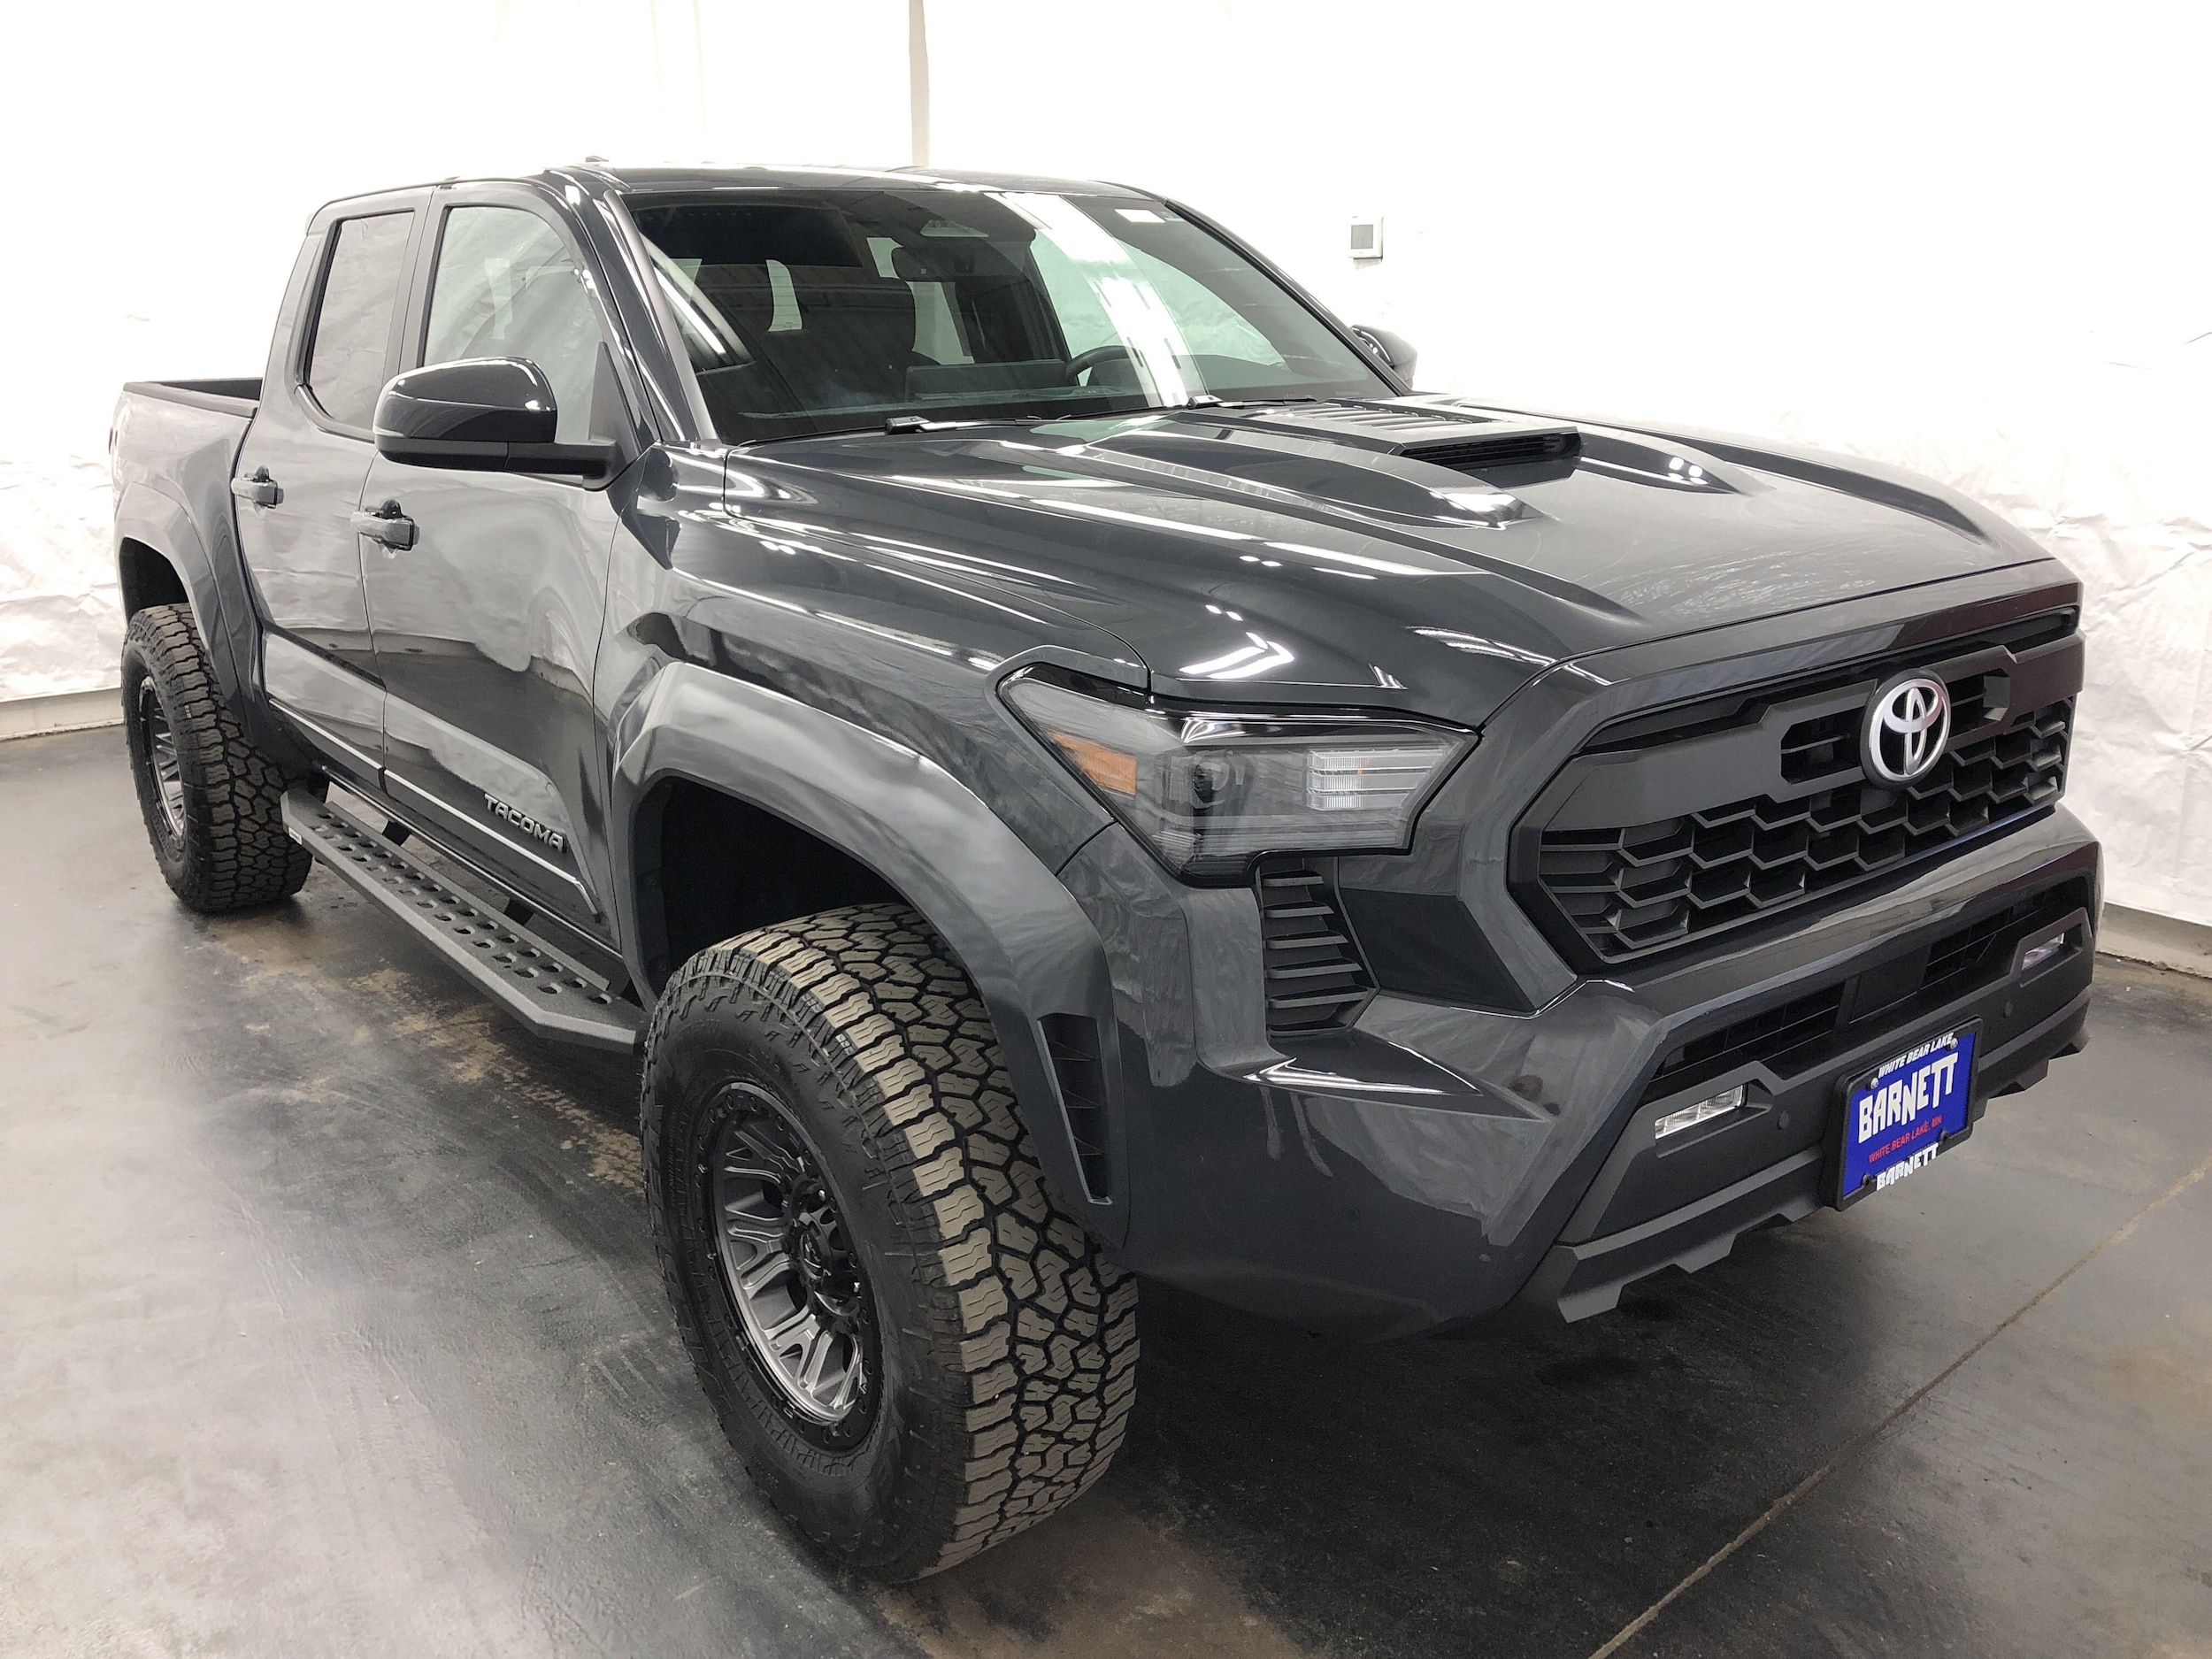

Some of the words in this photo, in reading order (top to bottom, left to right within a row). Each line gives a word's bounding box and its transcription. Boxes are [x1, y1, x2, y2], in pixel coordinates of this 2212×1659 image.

[485, 793, 564, 853] TACOMA
[1878, 1053, 1906, 1078] WHITE
[1907, 1043, 1931, 1063] BEAR
[1930, 1033, 1954, 1052] LAKE
[1858, 1053, 1958, 1143] BARNETT
[1869, 1144, 1891, 1163] WHITE
[1892, 1133, 1910, 1150] BEAR
[1876, 1142, 1939, 1190] BARNETT
